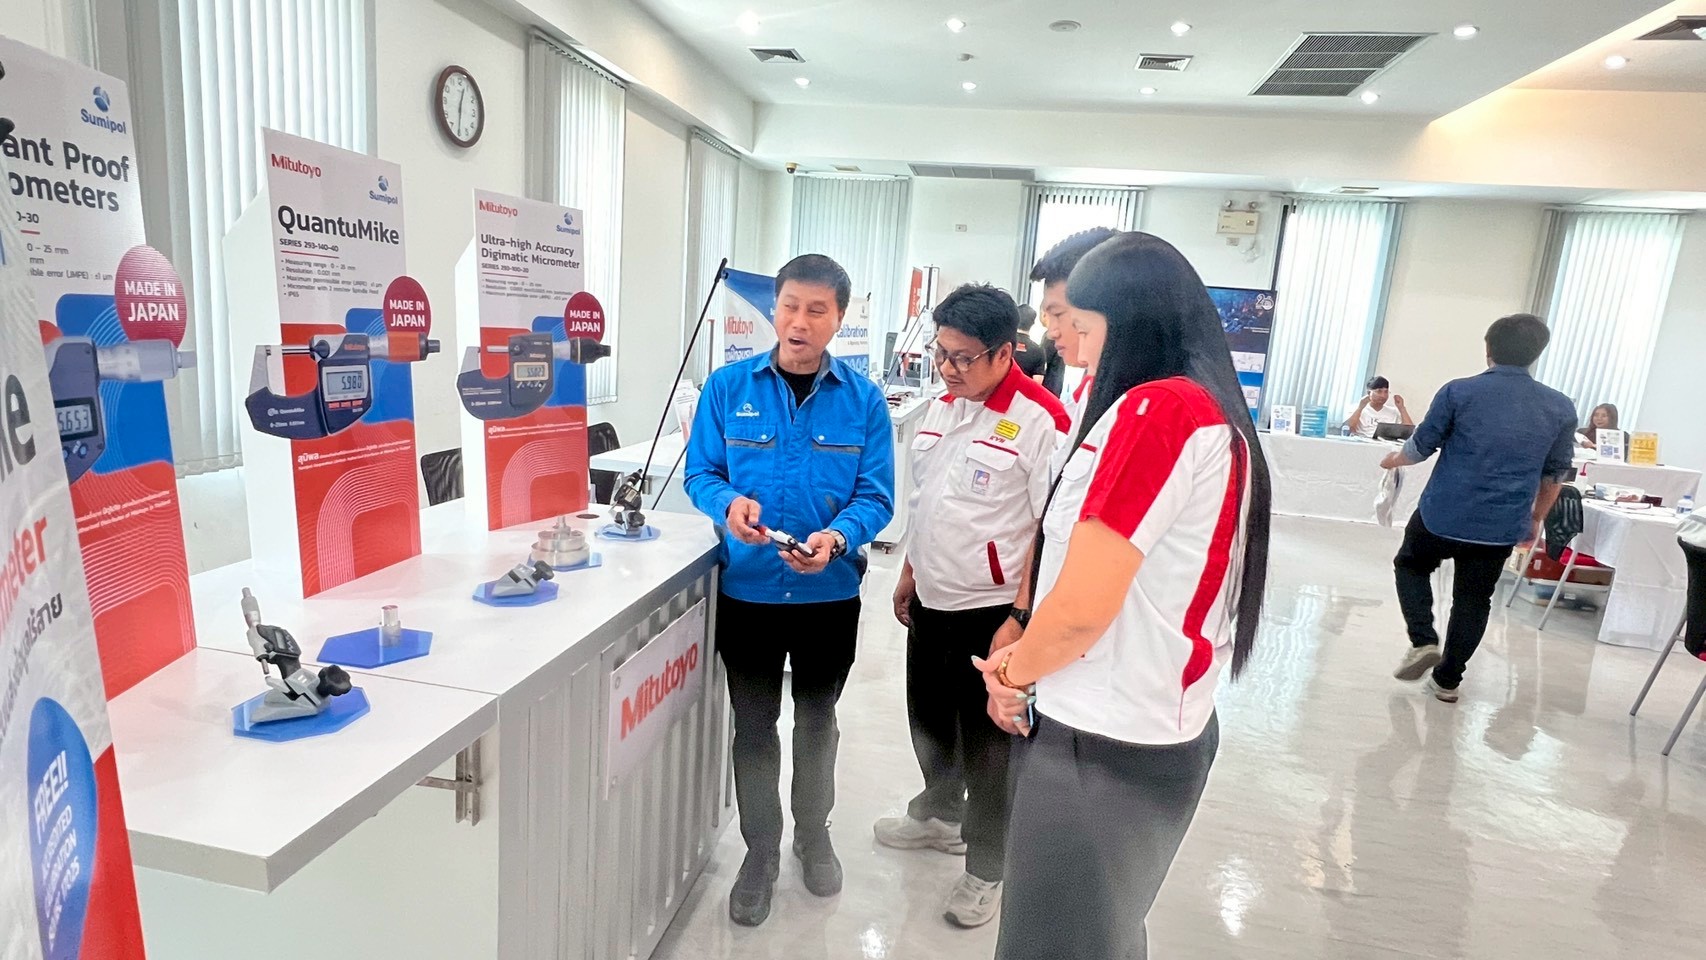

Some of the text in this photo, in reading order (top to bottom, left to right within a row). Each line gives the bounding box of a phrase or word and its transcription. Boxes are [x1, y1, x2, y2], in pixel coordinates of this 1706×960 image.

[81, 108, 126, 134] Sumipol
[63, 141, 129, 182] Proof
[271, 153, 321, 178] Mitutoyo
[369, 190, 398, 204] Sumipol
[479, 200, 518, 217] Mitutoyo
[278, 205, 399, 244] QuantuMike
[556, 225, 580, 235] Sumipol
[280, 238, 339, 252] SERIES 293-140-40
[481, 234, 574, 257] Ultra-high Accuracy
[482, 248, 580, 269] Digimatic Micrometer
[124, 281, 176, 296] MADE IN
[128, 303, 179, 321] JAPAN
[389, 299, 424, 311] MADE IN
[390, 314, 426, 327] JAPAN
[570, 310, 600, 319] MADE IN
[570, 322, 601, 332] JAPAN
[621, 642, 697, 740] Mitutoyo
